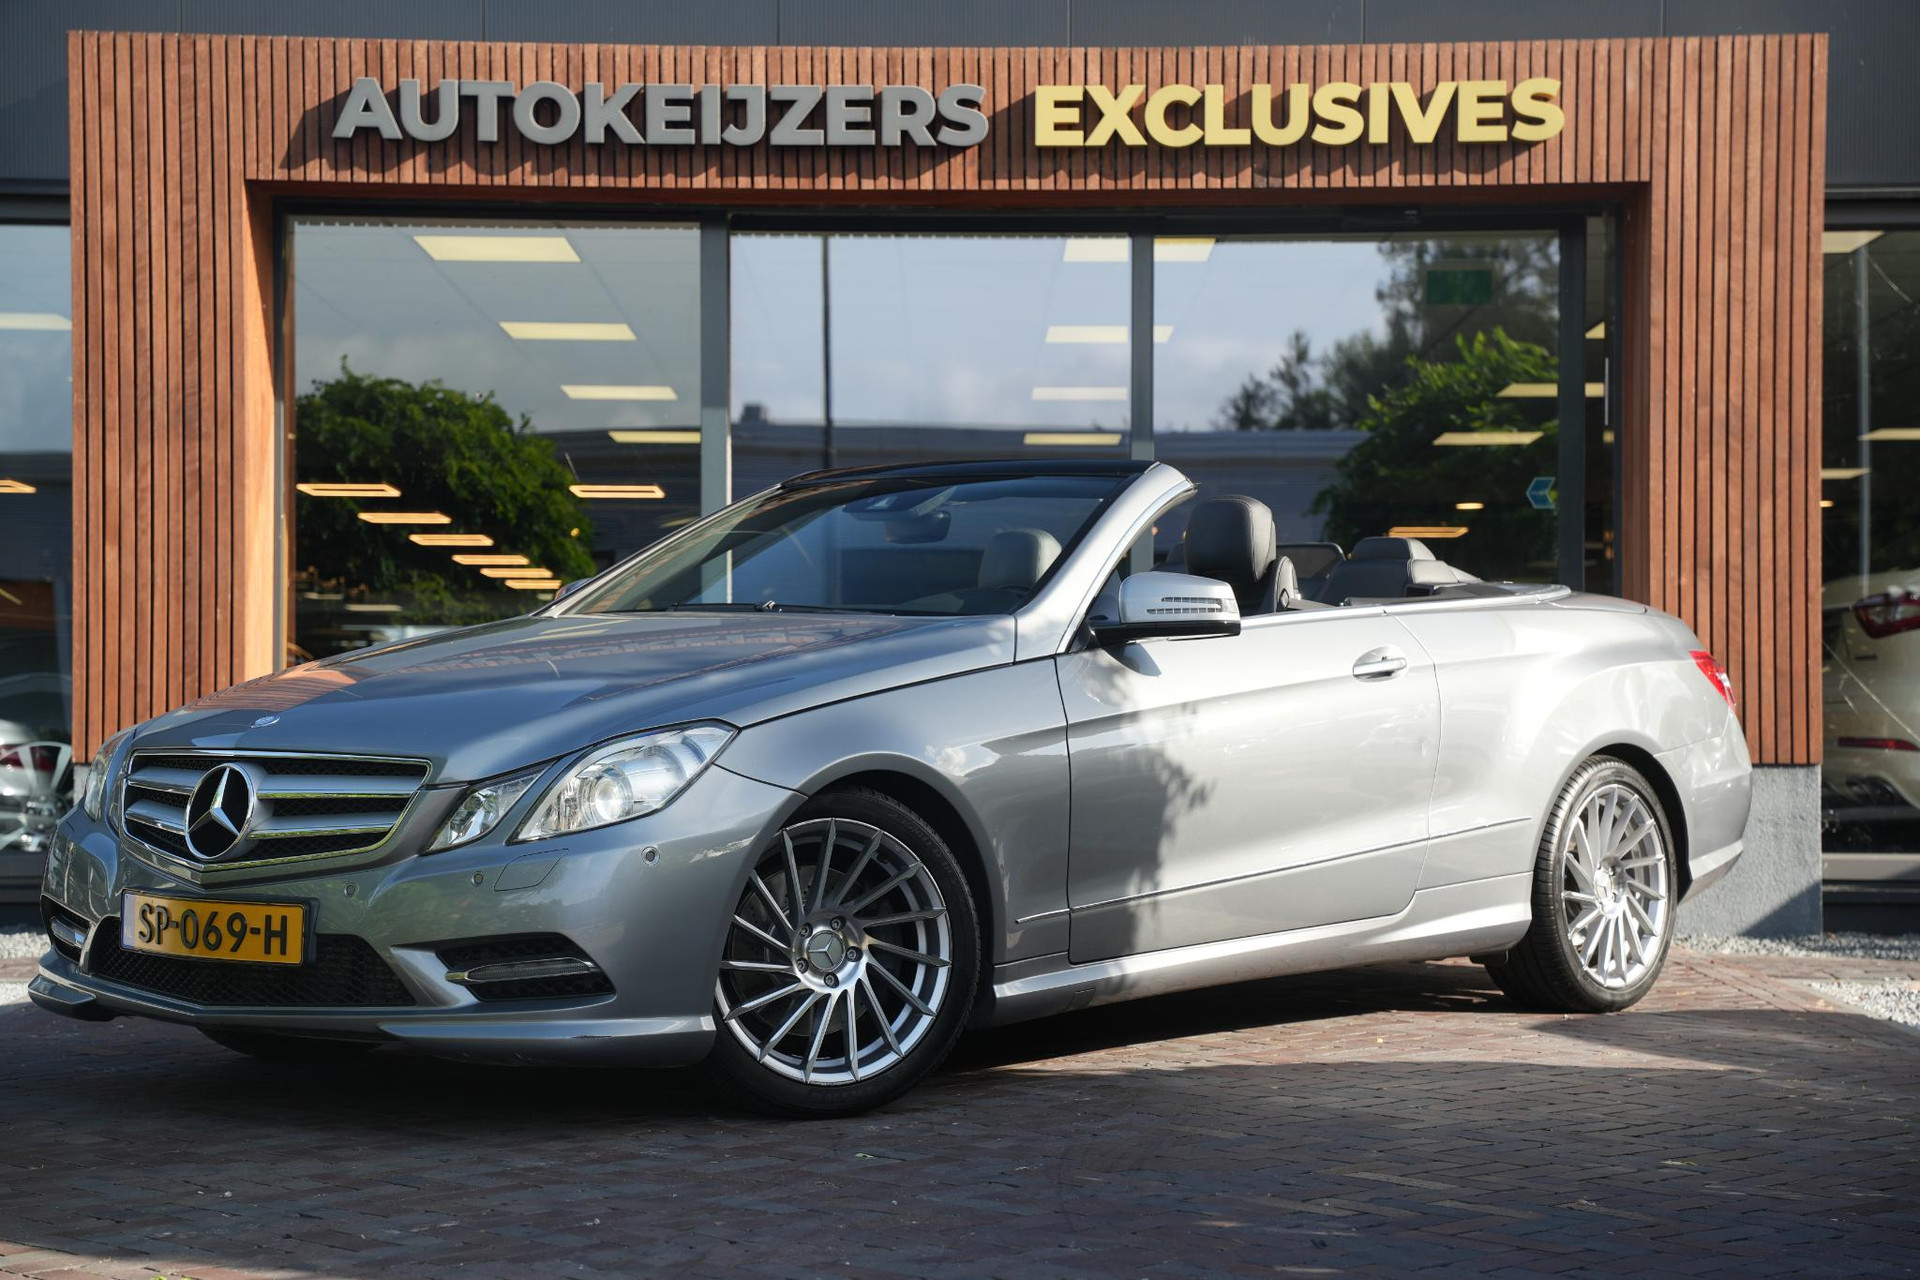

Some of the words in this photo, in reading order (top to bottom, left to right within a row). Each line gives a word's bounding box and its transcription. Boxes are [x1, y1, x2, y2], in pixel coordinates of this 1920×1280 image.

[332, 76, 989, 148] AUTOKEIJZERS
[1034, 77, 1565, 148] EXCLUSIVES
[138, 903, 288, 956] SP-069-H
